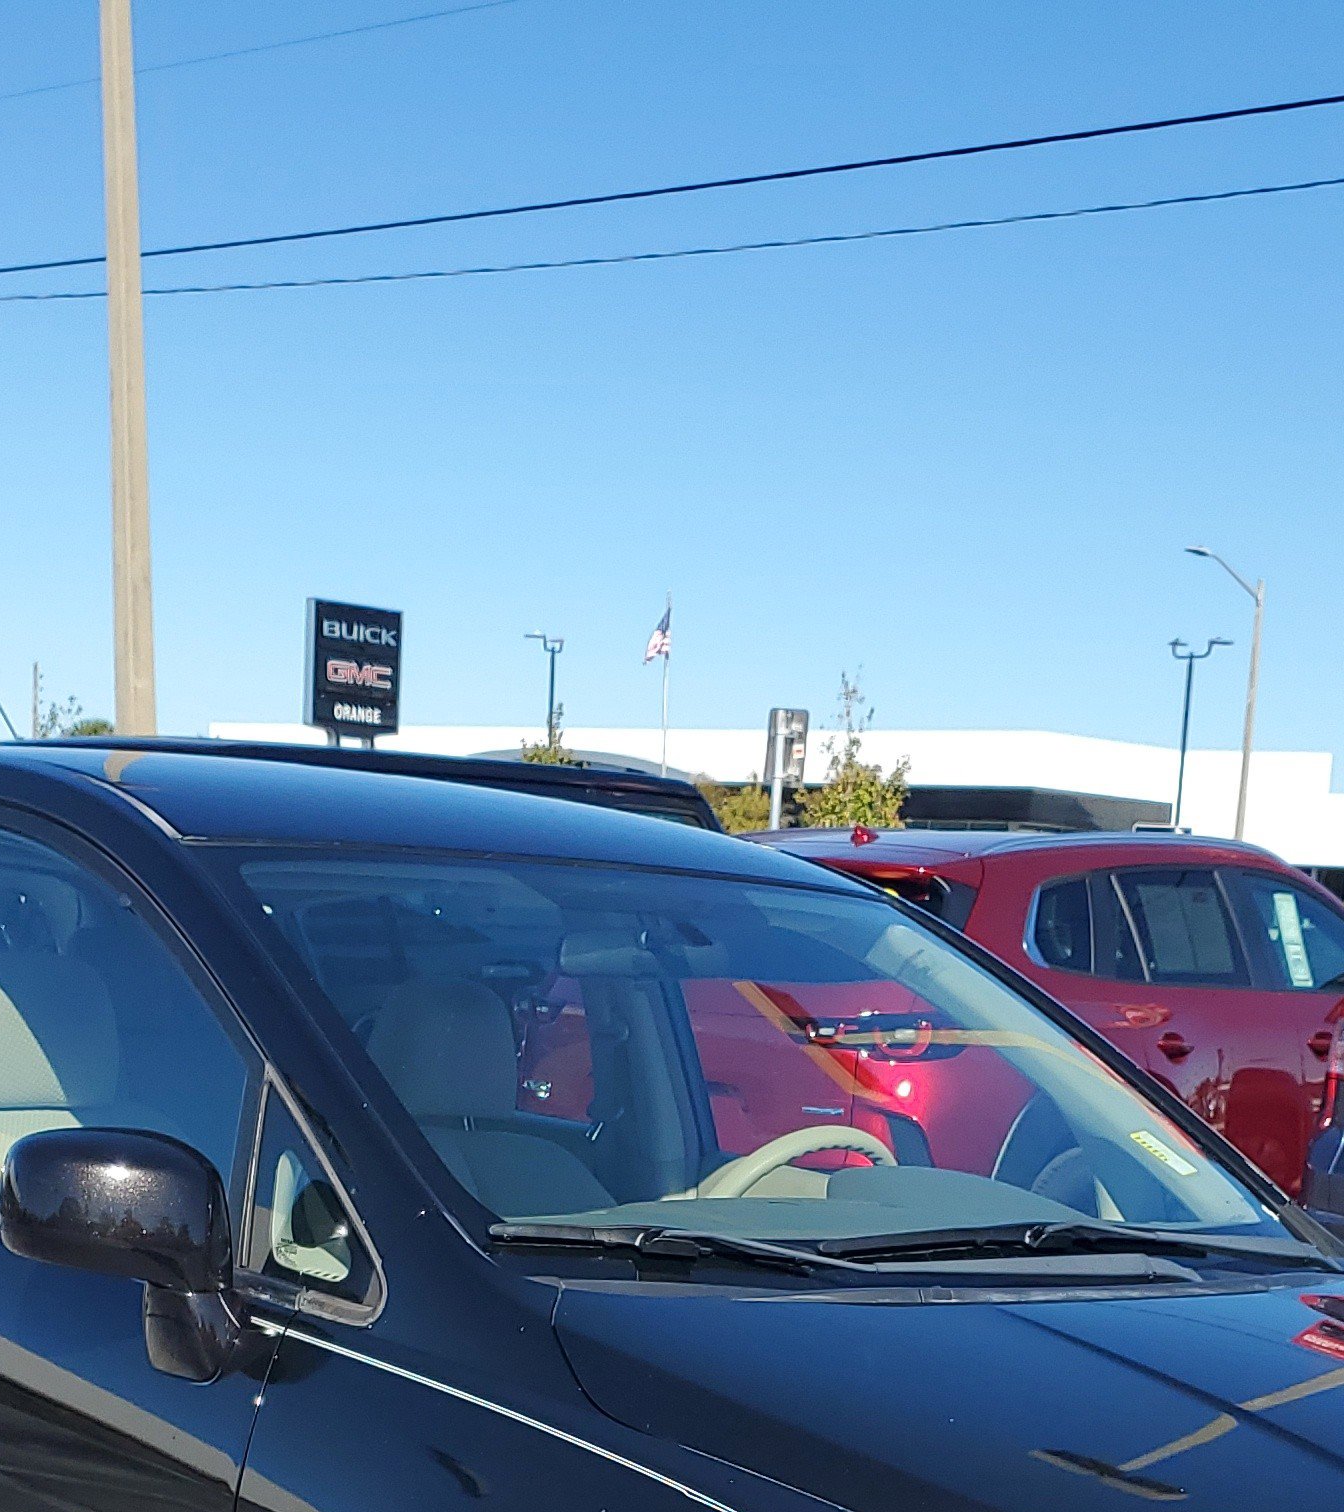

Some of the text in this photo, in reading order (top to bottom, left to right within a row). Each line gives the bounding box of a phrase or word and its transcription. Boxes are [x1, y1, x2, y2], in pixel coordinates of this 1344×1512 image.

[322, 617, 397, 647] BUICK
[326, 659, 392, 690] GMC
[333, 701, 382, 725] ORANGE
